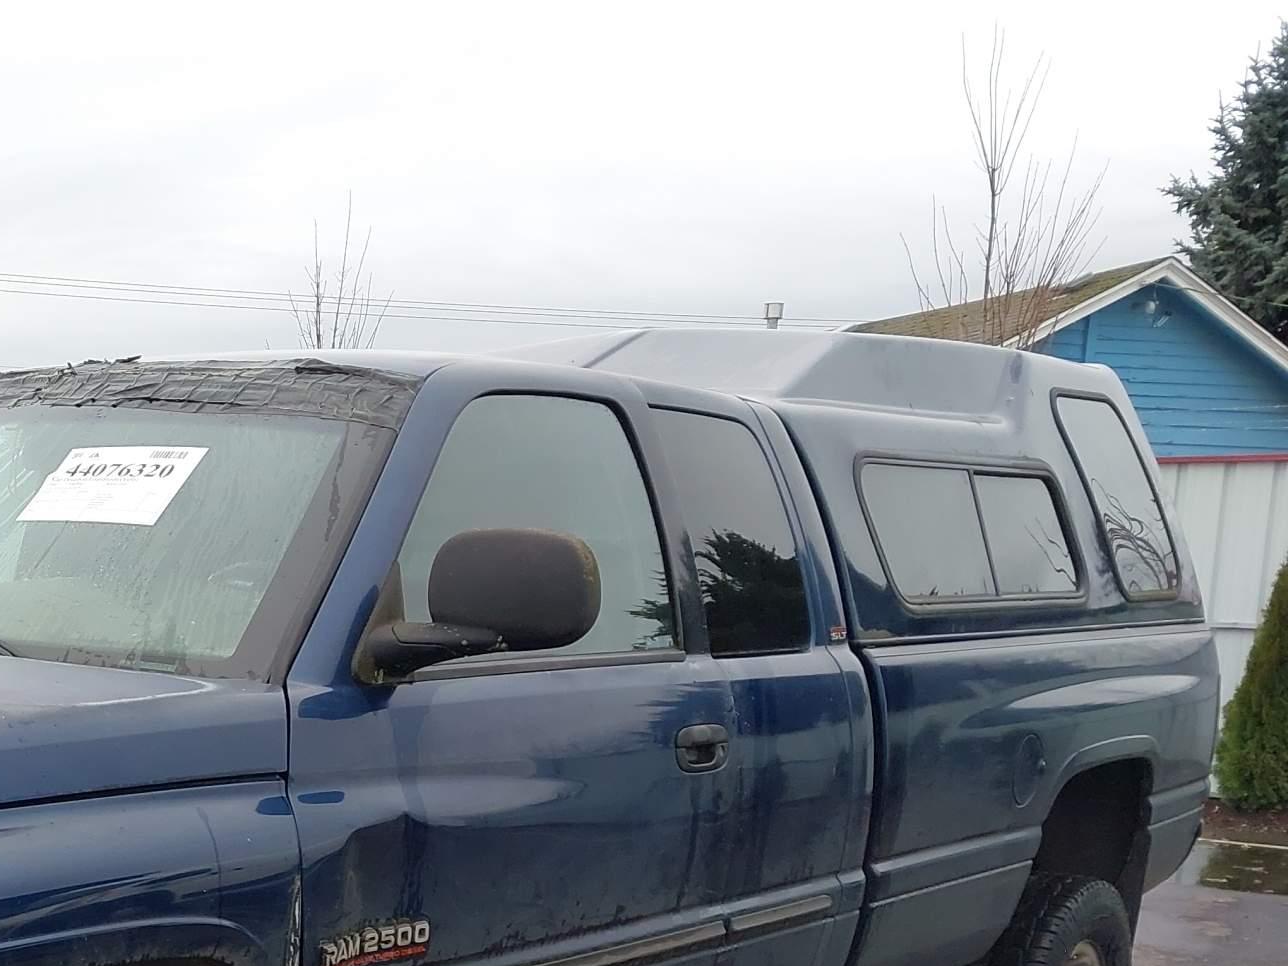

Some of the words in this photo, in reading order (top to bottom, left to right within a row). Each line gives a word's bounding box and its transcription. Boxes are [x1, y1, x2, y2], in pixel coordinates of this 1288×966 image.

[66, 463, 175, 479] 44076320
[830, 631, 847, 641] SLT
[362, 920, 430, 953] 2500
